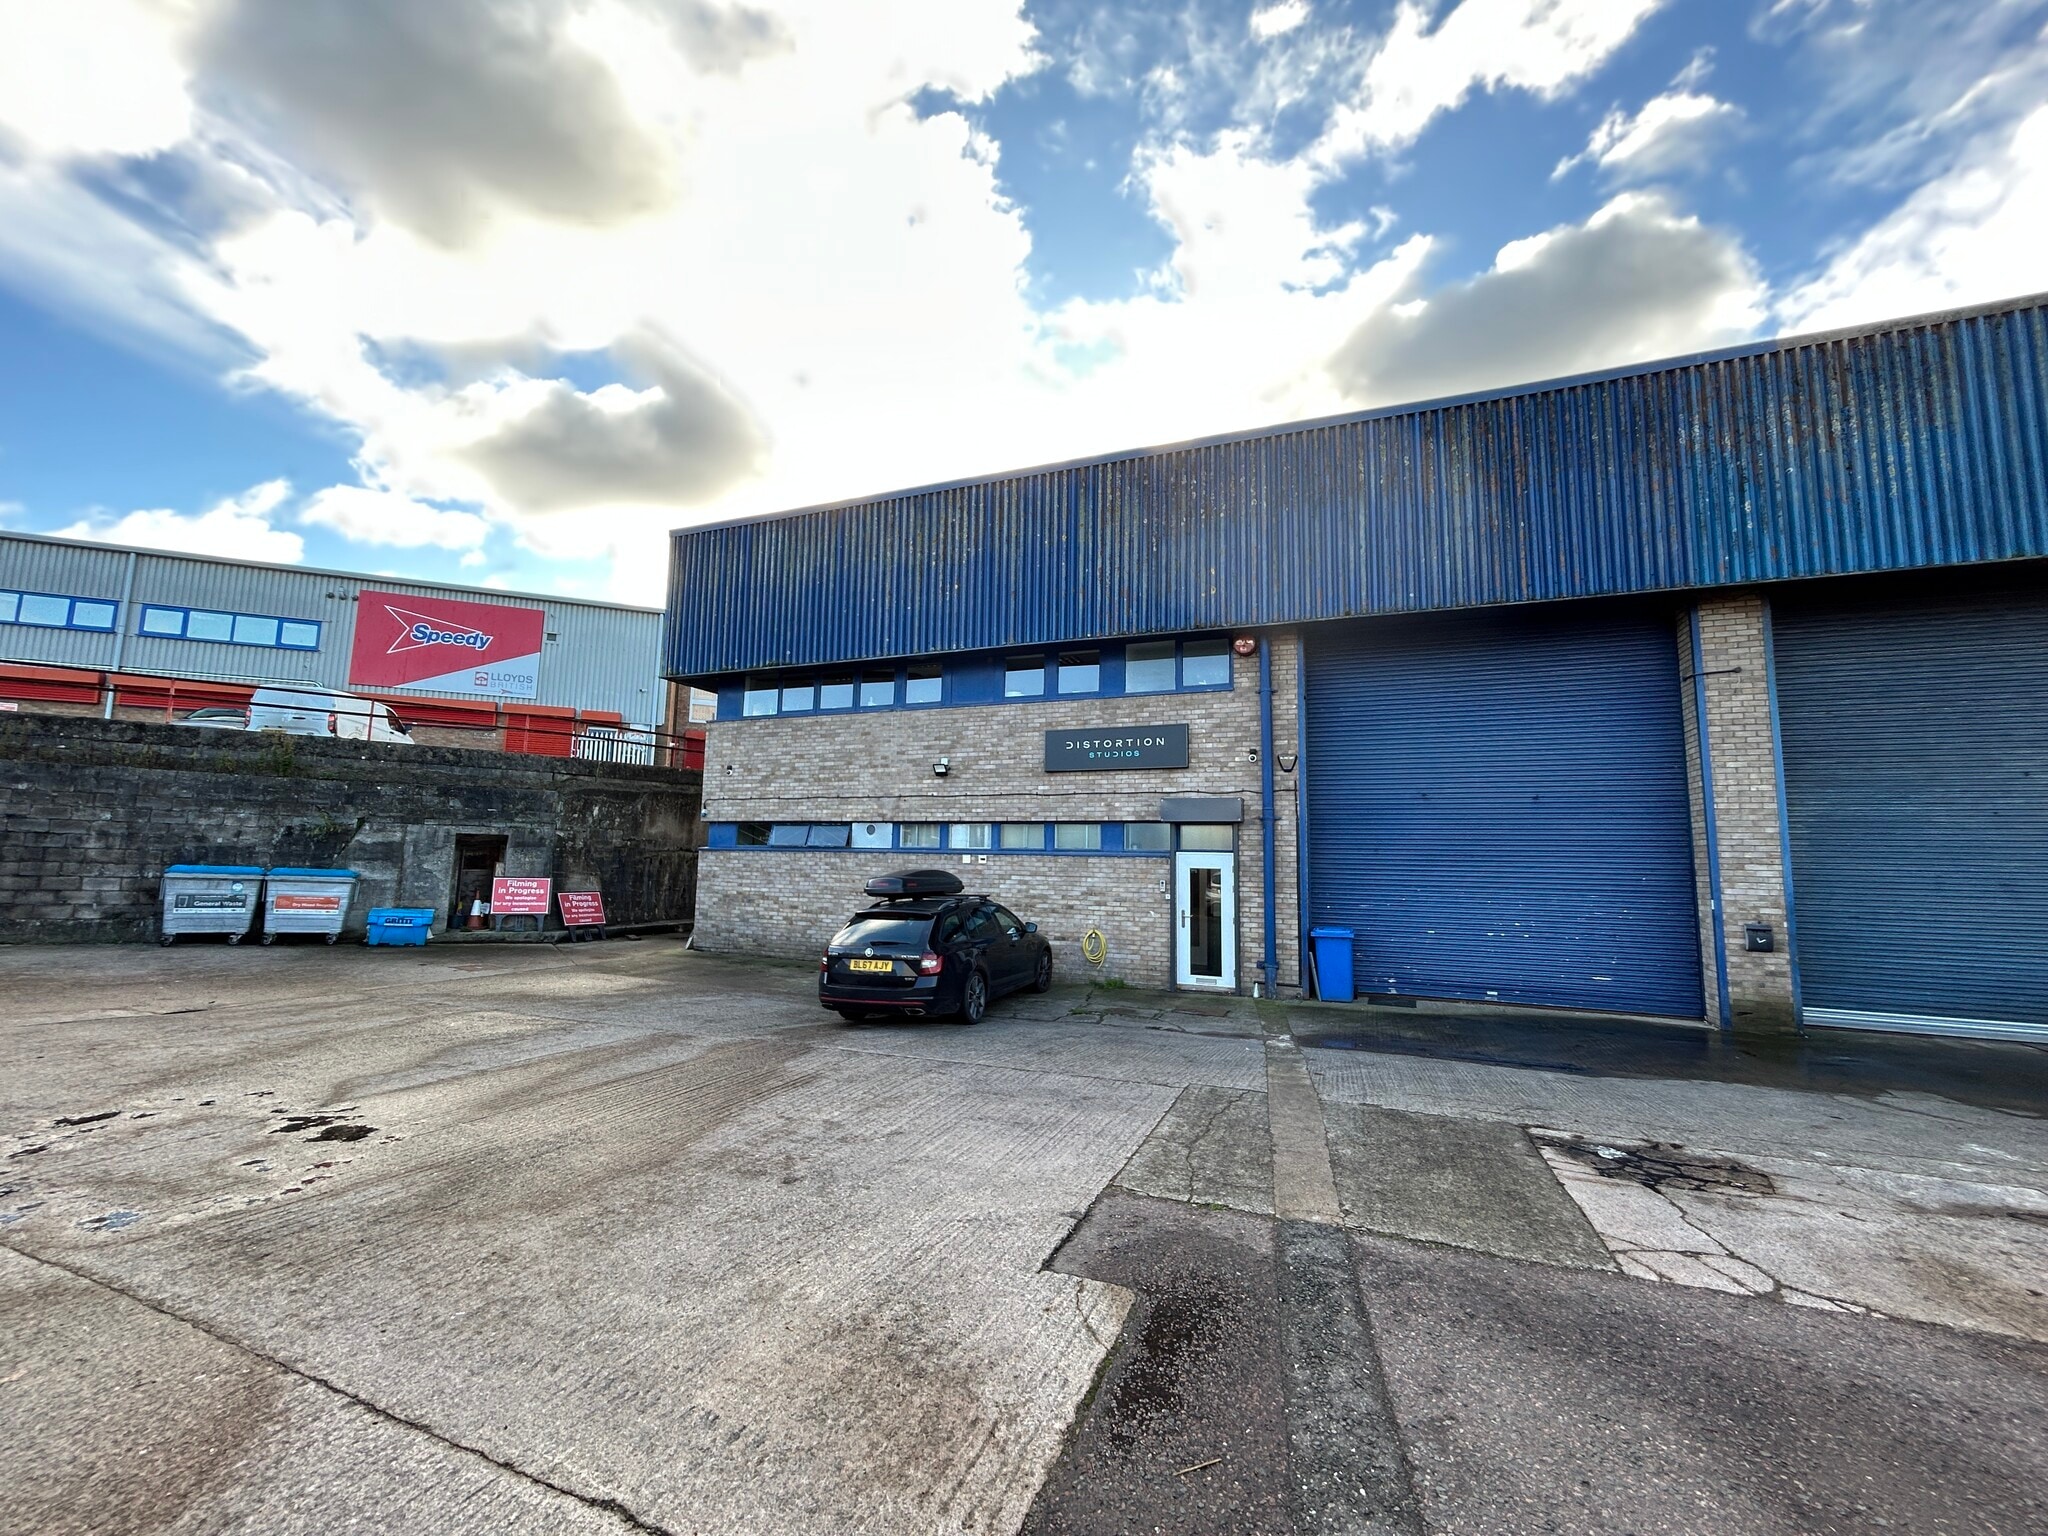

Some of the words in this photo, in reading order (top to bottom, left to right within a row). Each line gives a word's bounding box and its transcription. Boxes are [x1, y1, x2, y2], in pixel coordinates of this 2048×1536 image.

[410, 623, 493, 650] Speedy
[490, 672, 533, 684] LLOYDS
[490, 681, 533, 691] BRITISH
[1065, 737, 1165, 749] DISTORTION
[1089, 750, 1140, 759] STUDIOS
[507, 880, 537, 888] Filming
[508, 887, 545, 895] Progress
[853, 960, 873, 969] BL67
[873, 961, 890, 970] AJY
